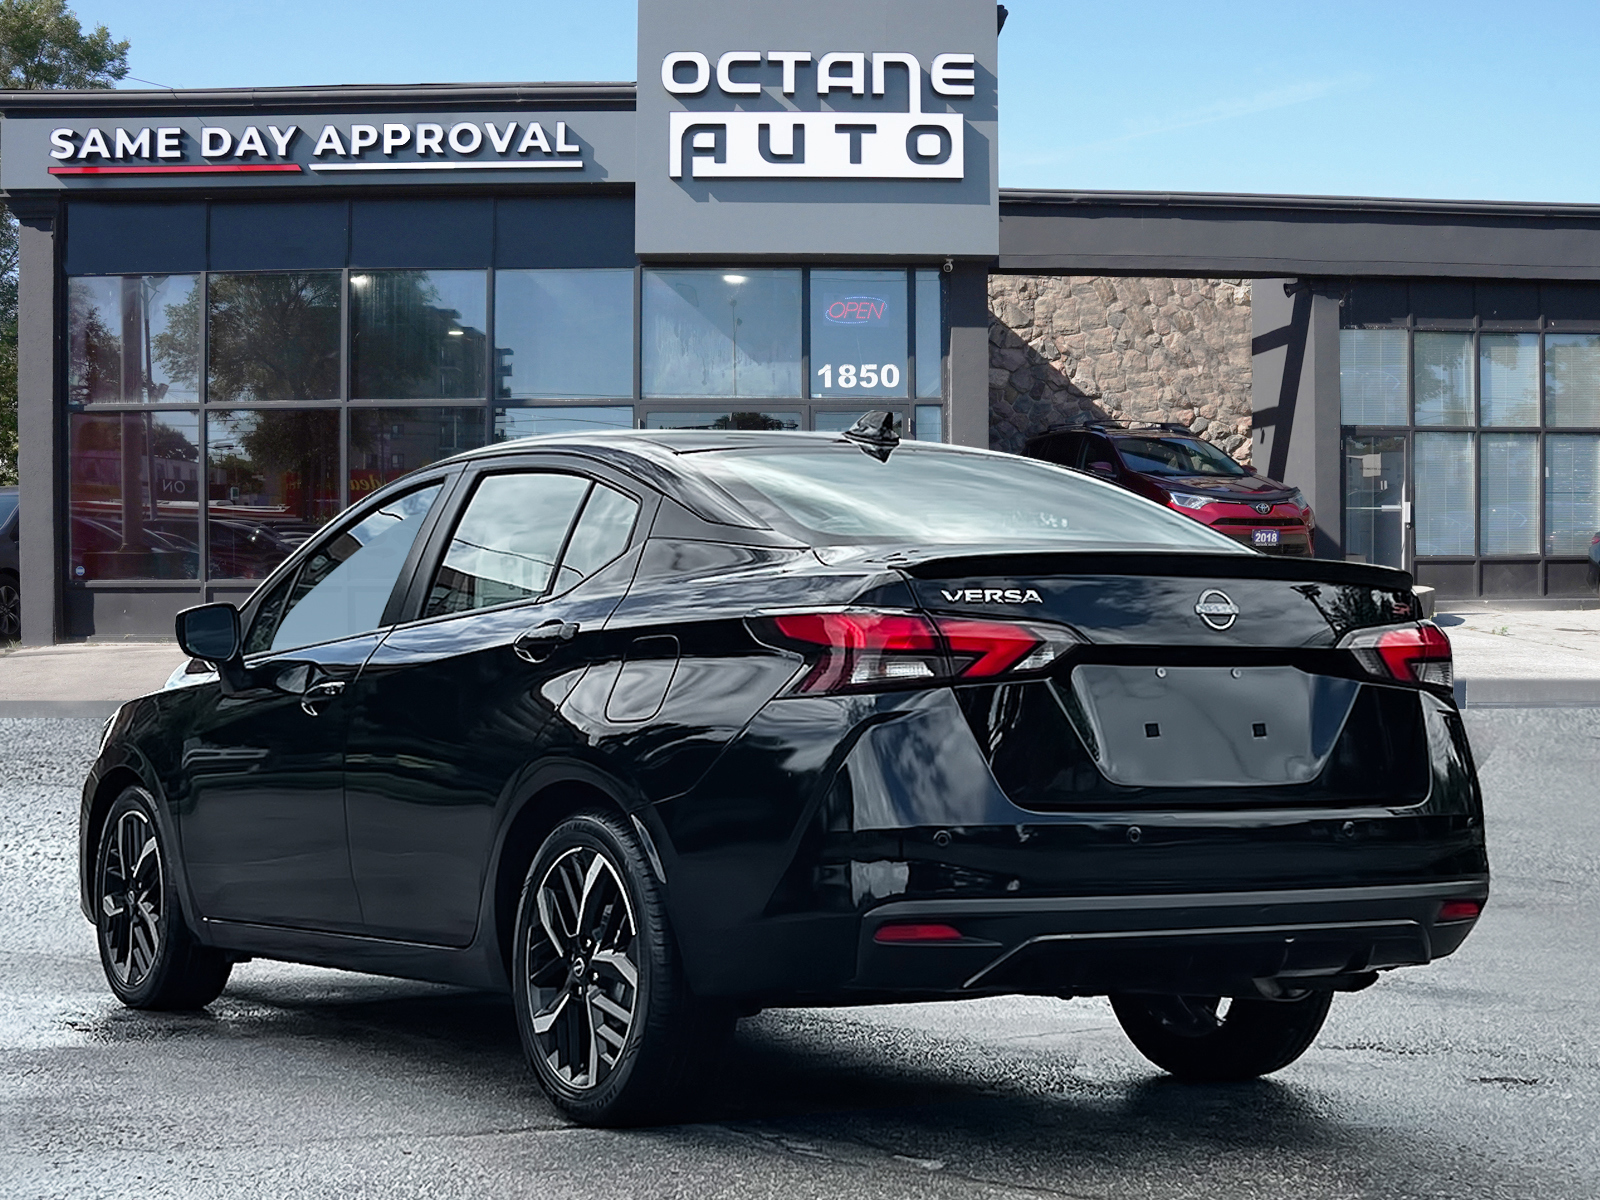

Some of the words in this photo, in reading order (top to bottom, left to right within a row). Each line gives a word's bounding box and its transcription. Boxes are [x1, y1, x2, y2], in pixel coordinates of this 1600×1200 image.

[661, 51, 976, 96] OCTANE
[49, 126, 183, 160] SAME
[200, 124, 299, 159] DAY
[312, 121, 581, 156] APPROVAL
[680, 122, 954, 178] AUTO
[829, 301, 885, 319] OPEN
[817, 363, 900, 389] 1850
[1255, 532, 1278, 543] 2018
[941, 589, 1043, 603] VERSA
